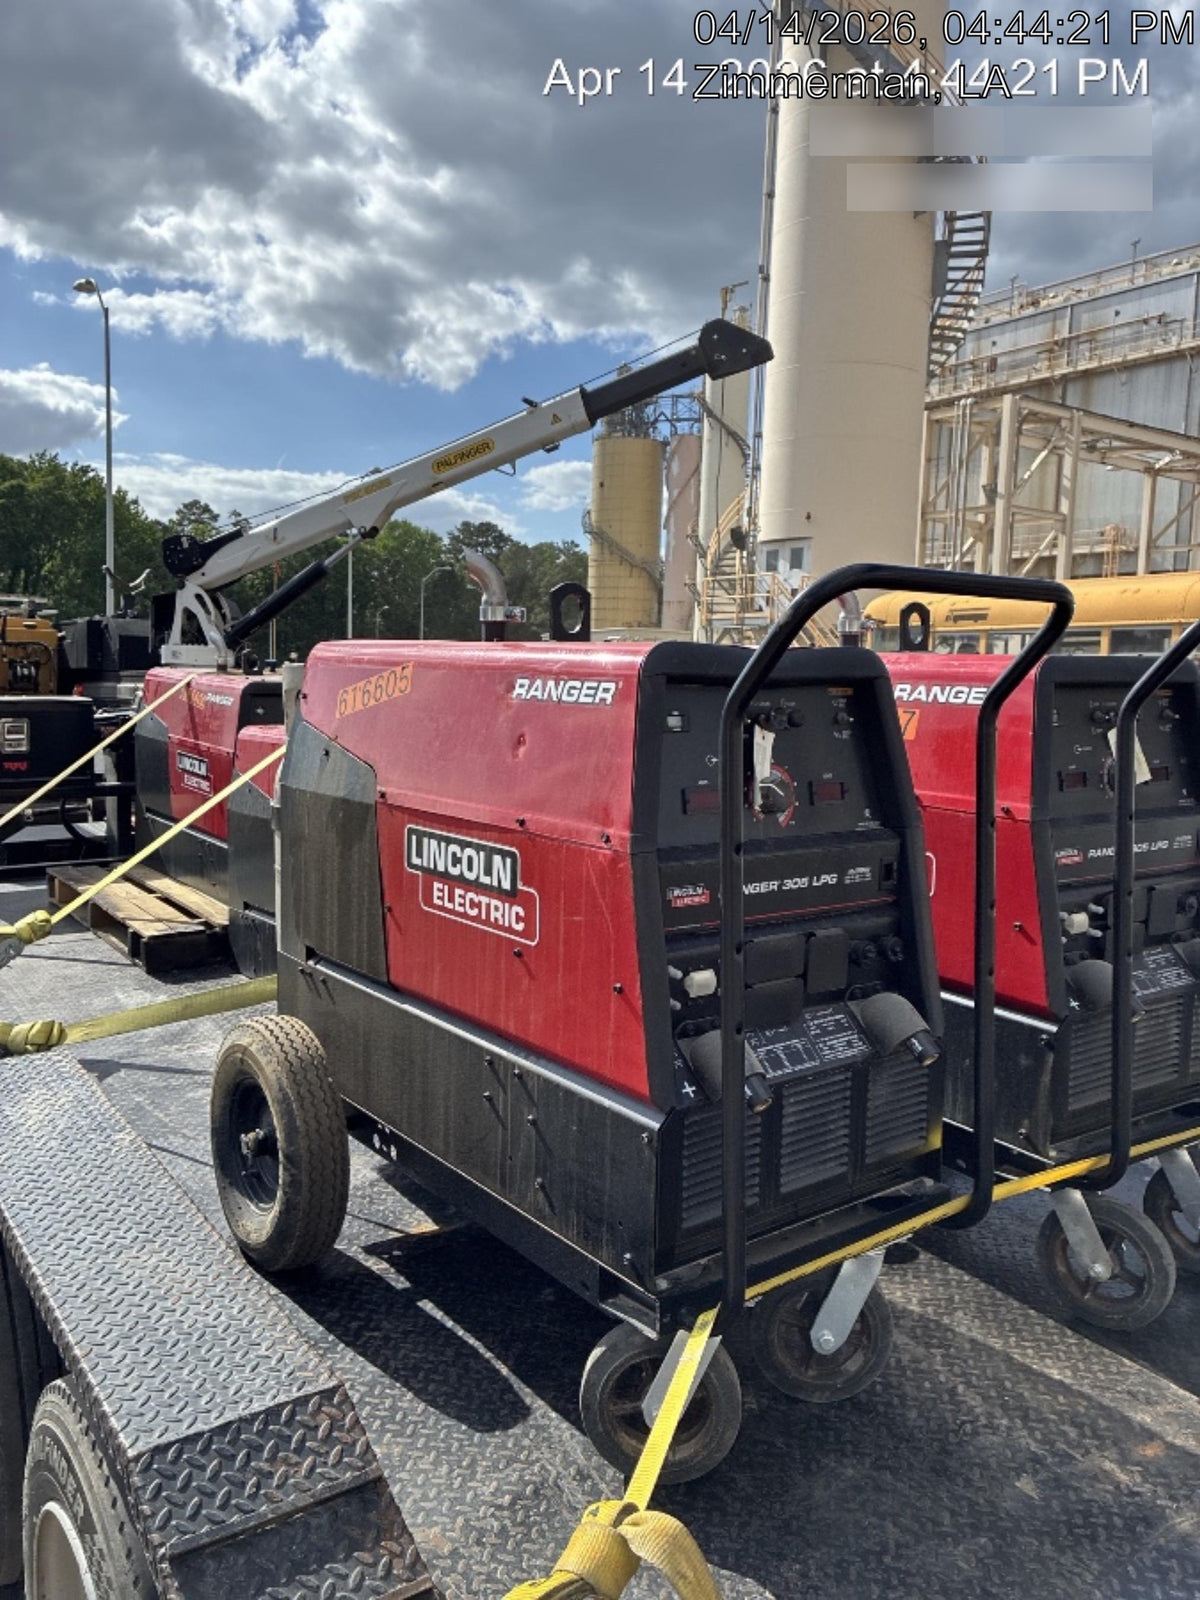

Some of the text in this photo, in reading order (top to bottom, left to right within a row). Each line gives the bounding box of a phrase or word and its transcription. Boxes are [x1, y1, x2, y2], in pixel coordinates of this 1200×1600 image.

[512, 678, 616, 705] RANGER
[893, 683, 989, 705] RANGE
[410, 834, 512, 891] LINCOLN
[742, 881, 779, 895] NGER
[782, 876, 809, 890] 305
[812, 873, 838, 887] LPG
[432, 881, 525, 932] ELECTRIC
